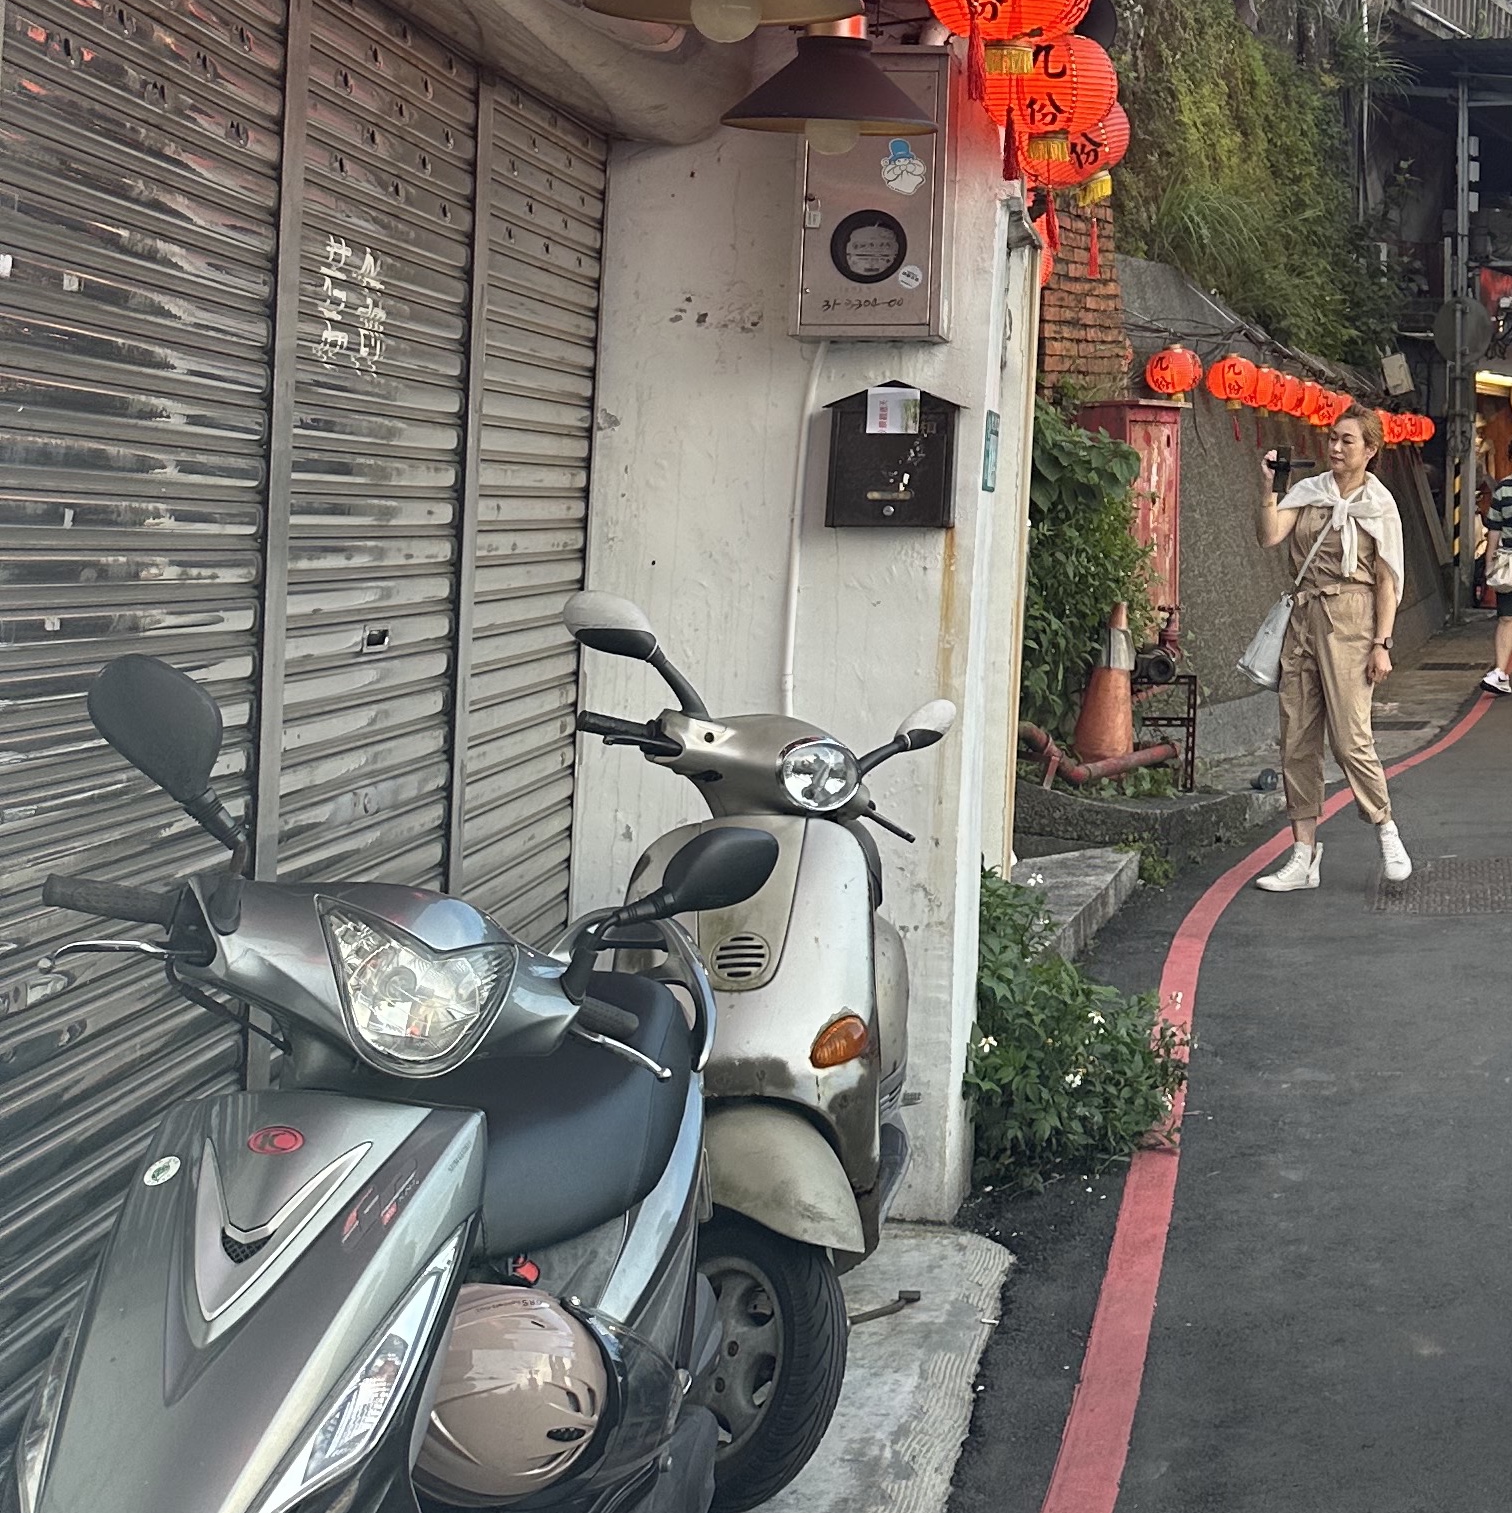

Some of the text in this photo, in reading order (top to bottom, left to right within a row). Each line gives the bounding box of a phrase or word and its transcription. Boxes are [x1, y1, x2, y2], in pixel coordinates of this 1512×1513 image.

[1025, 42, 1069, 127] 九份
[1153, 356, 1172, 391] 九份
[1226, 363, 1243, 396] 九份
